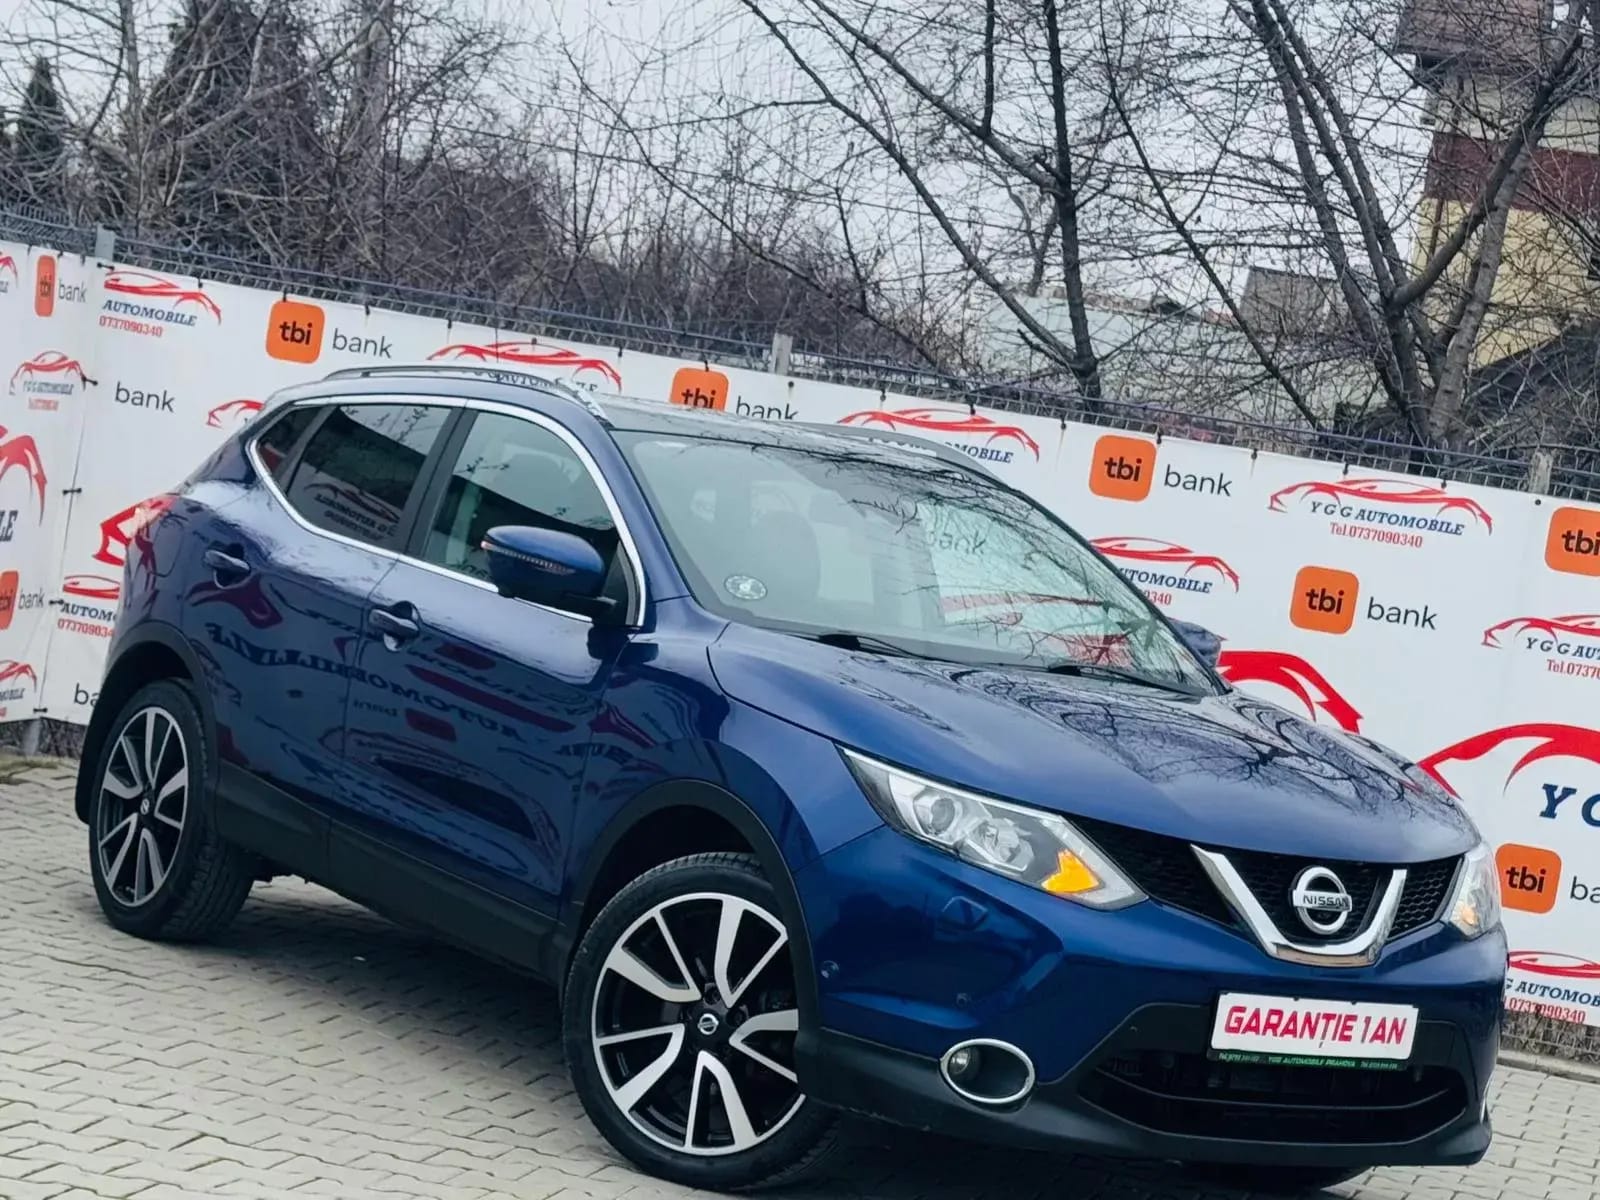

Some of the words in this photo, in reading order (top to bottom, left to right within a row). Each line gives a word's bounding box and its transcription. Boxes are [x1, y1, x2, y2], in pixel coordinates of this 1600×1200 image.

[58, 279, 87, 302] bank
[98, 315, 164, 338] 0737090340
[102, 299, 198, 327] AUTOMOBILE
[279, 320, 312, 346] tbi
[332, 328, 393, 359] bank
[115, 381, 175, 412] bank
[1104, 457, 1142, 483] tbi
[1164, 464, 1234, 497] bank
[1354, 508, 1465, 536] AUTOMOBILE
[1561, 528, 1600, 556] tbi
[18, 587, 45, 609] bank
[1305, 588, 1345, 614] tbi
[1366, 597, 1437, 631] bank
[1506, 864, 1546, 894] tbi
[1303, 894, 1348, 908] NISSAN
[1369, 1017, 1407, 1044] AN
